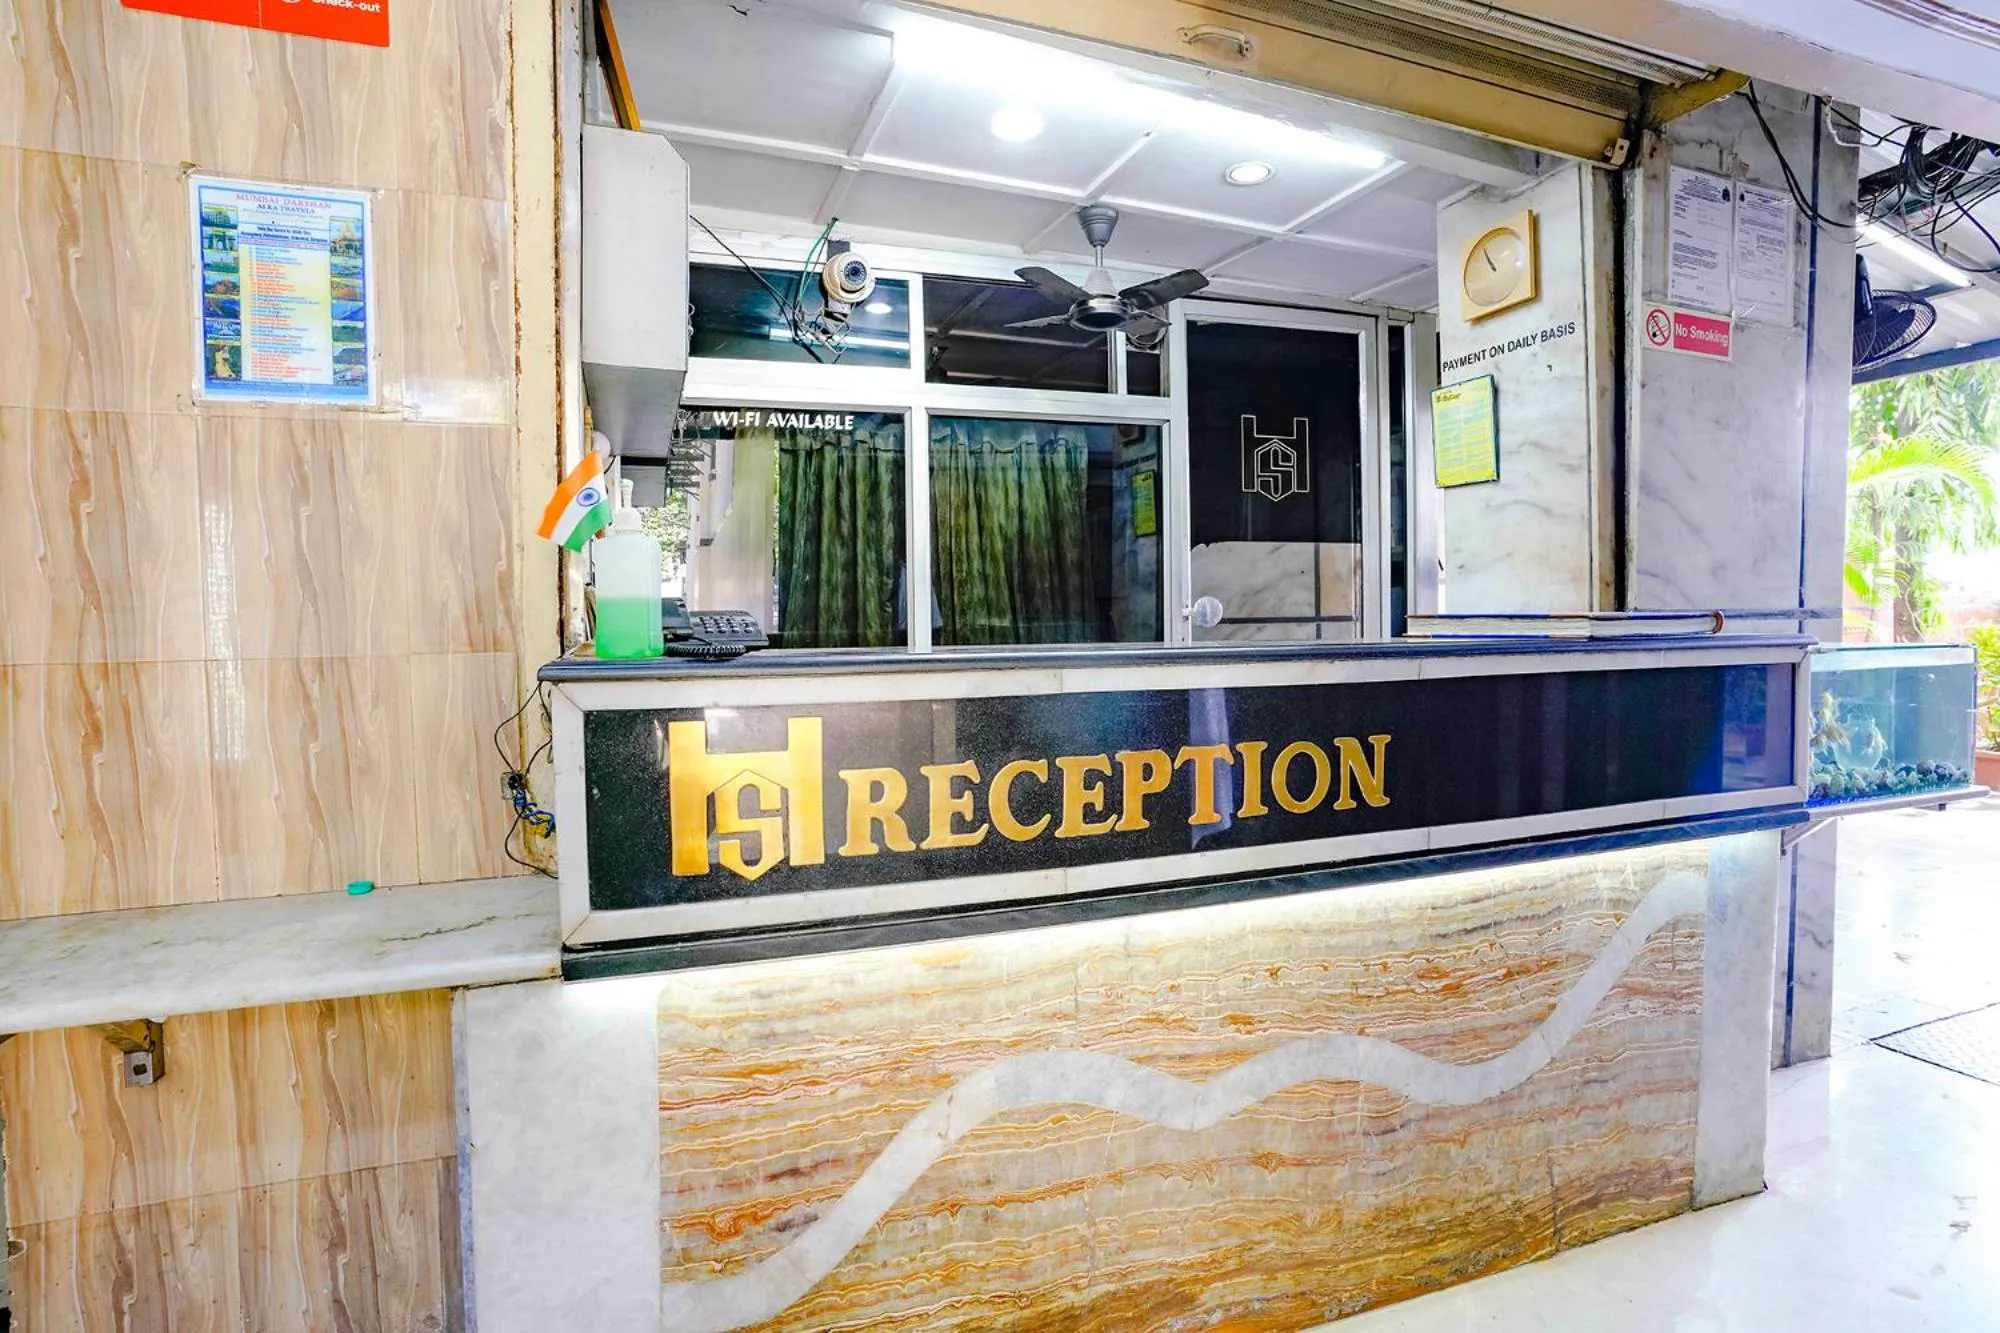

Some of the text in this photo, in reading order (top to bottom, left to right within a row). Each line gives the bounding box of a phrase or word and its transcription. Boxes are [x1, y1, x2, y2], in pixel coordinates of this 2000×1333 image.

[1442, 321, 1576, 373] PAYMENT ON DAILY BASIS
[1675, 322, 1729, 348] No Smoking
[712, 411, 855, 430] WI-FI AVAILABLE
[838, 734, 1391, 857] RECEPTION
